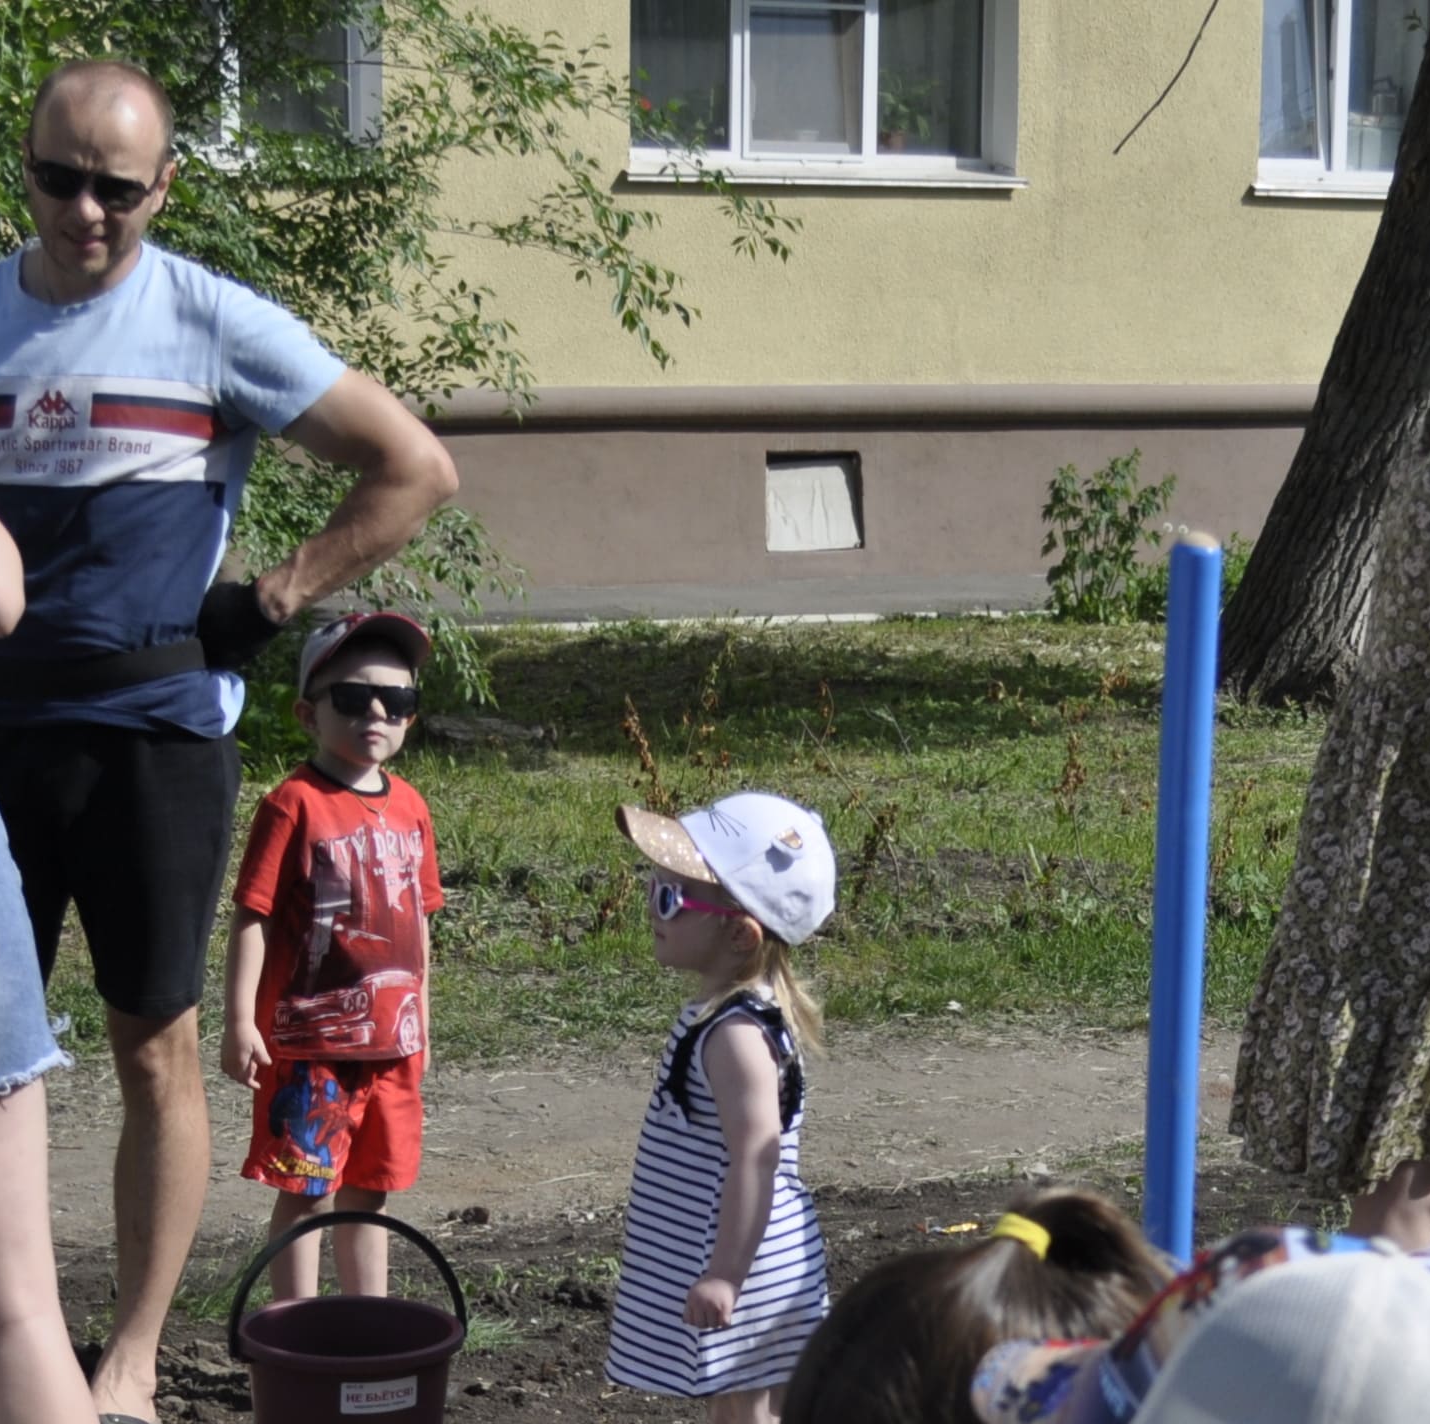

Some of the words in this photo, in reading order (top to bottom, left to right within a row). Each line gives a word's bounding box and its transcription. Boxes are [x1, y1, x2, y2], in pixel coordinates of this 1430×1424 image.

[27, 413, 77, 433] Kappa
[24, 437, 102, 454] Sportswear
[108, 437, 153, 455] Brand
[14, 458, 49, 475] Since
[346, 1393, 364, 1404] НЕ
